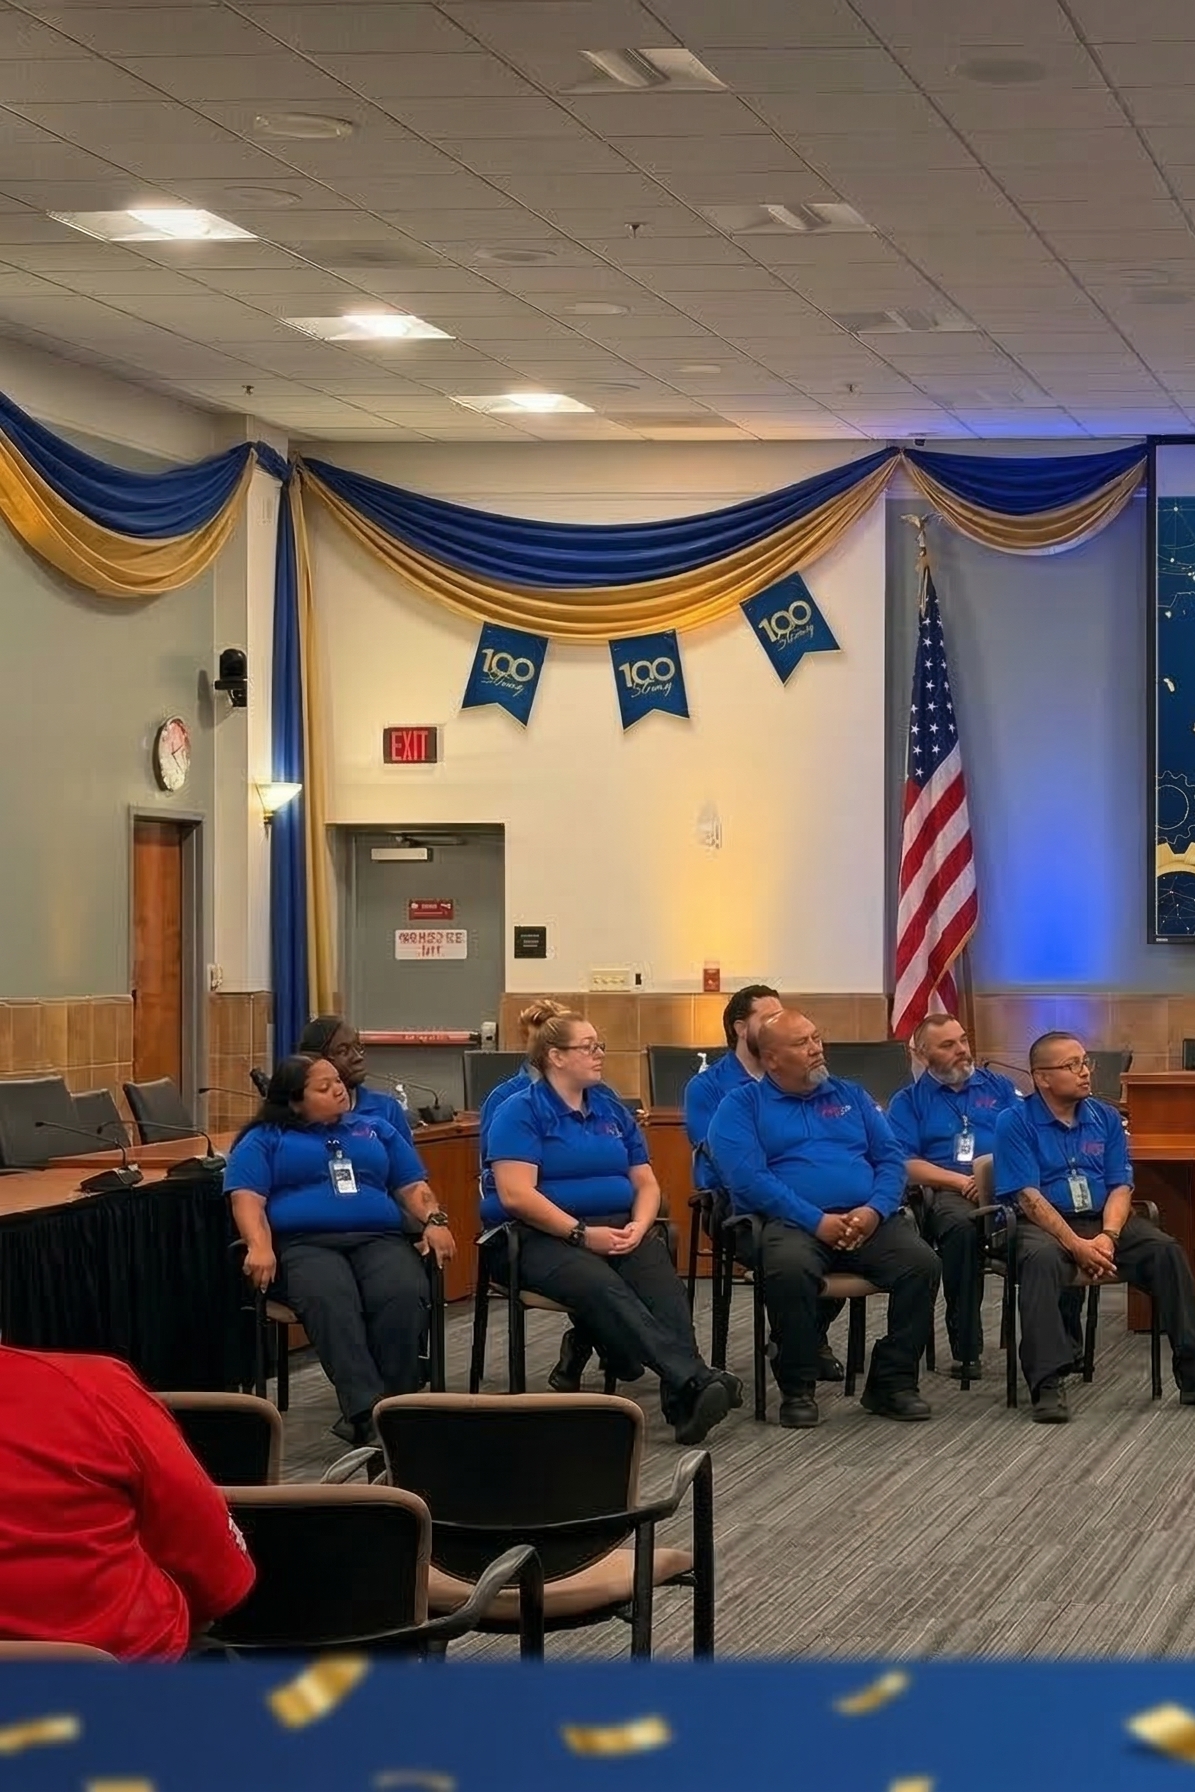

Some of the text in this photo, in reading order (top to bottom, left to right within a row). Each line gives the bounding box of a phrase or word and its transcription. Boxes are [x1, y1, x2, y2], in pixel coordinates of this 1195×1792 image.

[758, 599, 812, 643] 100
[481, 647, 535, 682] 100
[618, 656, 676, 688] 100
[391, 730, 428, 760] EXIT
